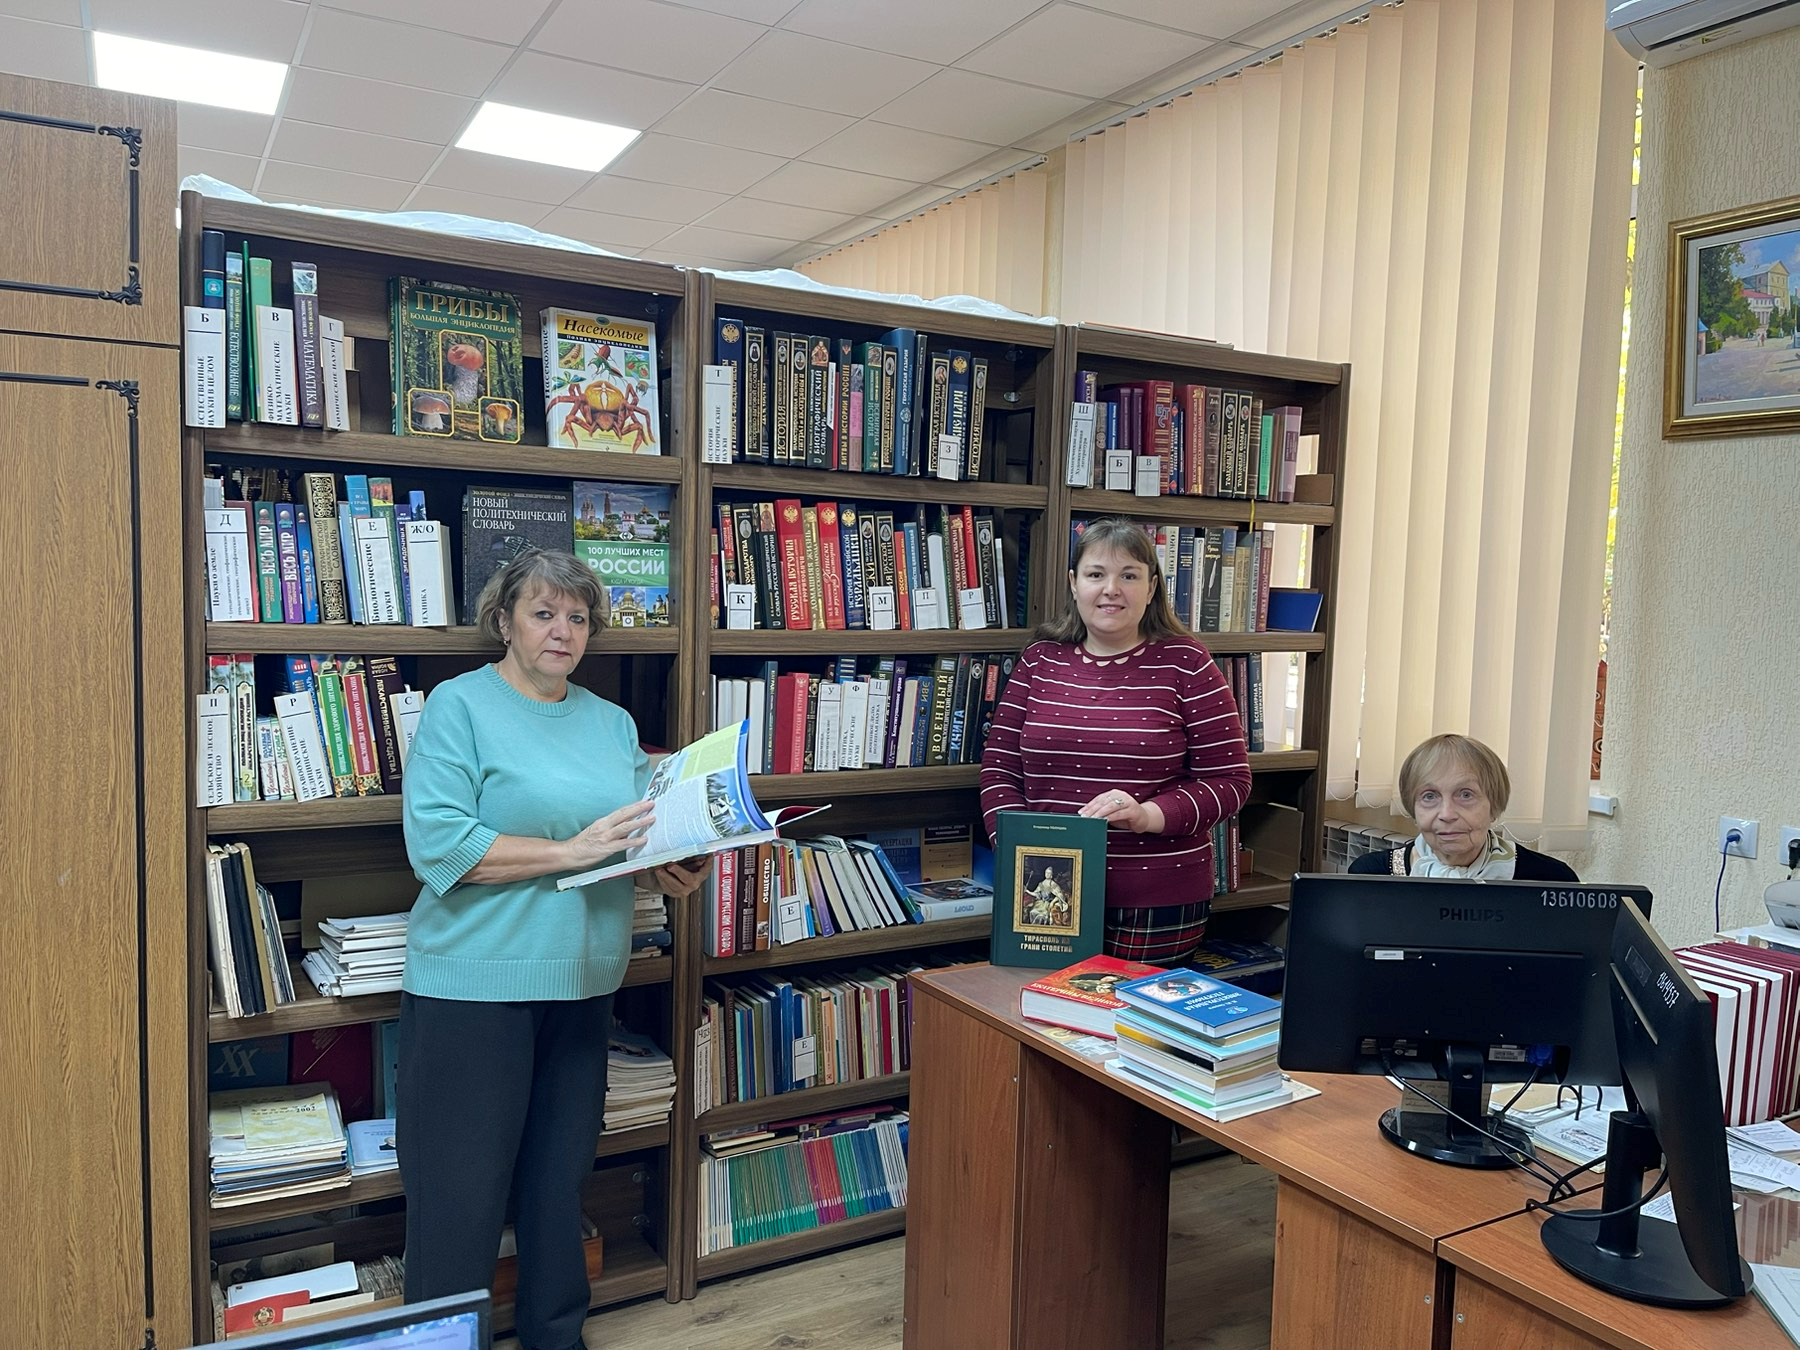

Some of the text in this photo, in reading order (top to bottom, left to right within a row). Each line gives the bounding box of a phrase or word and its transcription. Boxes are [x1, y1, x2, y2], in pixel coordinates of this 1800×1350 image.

[200, 312, 210, 322] Б
[272, 312, 279, 322] В
[416, 290, 510, 324] ГРИБЫ
[329, 322, 334, 332] Г
[410, 312, 516, 334] БОЛЬШАЯ ЭНЦИКЛОПЕДИЯ
[564, 319, 644, 342] Насекомые
[207, 356, 216, 387] ЦЕЛОМ
[229, 332, 239, 396] ЕСТЕСТВОЗНАНИЕ
[302, 340, 316, 406] МАТЕМАТИКА
[543, 329, 551, 399] Насекомые
[197, 356, 205, 426] ЕСТЕСТВЕННЫЕ
[274, 340, 282, 421] МАТЕМАТИЧЕСКИЕ
[842, 364, 850, 397] РОССИИ
[266, 384, 274, 421] ФИЗИКО-
[284, 394, 292, 423] НАУКИ
[332, 373, 342, 428] ХИМИЧЕСКИЕ
[814, 370, 822, 454] БИОГРАФИЧЕСКИЙ
[952, 390, 963, 418] ЦАРИ
[1078, 405, 1088, 414] Ш
[777, 405, 786, 455] ИСТОРИЯ
[840, 442, 848, 465] БИТВЫ
[971, 426, 980, 473] ИСТОРИЯ
[1146, 458, 1152, 466] В
[473, 496, 508, 508] НОВЫЙ
[473, 509, 567, 522] ПОЛИТЕХНИЧЕСКИЙ
[220, 514, 231, 526] Д
[368, 522, 377, 531] Е
[411, 525, 434, 534] Ж/О
[473, 520, 515, 530] СЛОВАРЬ
[210, 548, 218, 573] земле
[258, 526, 276, 574] ВЕСЬ МИР
[281, 532, 297, 581] ВЕСЬ МИР
[315, 520, 328, 579] ГЕОГРАФИЧЕСКИЙ
[330, 529, 340, 568] СЛОВАРЬ
[399, 527, 409, 573] ЗАГАДОЧНЫХ
[604, 548, 641, 556] ЛУЧШИХ
[643, 549, 664, 557] МЕСТ
[785, 539, 795, 579] ИСТОРИЯ
[843, 534, 852, 577] РОССИЙСКОЙ
[304, 565, 312, 582] ВЕСЬ
[588, 558, 665, 575] РОССИИ
[805, 530, 818, 611] ДОМАШНЯЯ ЖИЗНЬ
[851, 534, 864, 607] ГЕРАЛЬДИКИ
[982, 545, 992, 585] СЛОВАРЬ
[212, 581, 220, 607] Науки
[364, 543, 380, 622] Биологические
[384, 591, 394, 621] науки
[736, 595, 745, 604] К
[788, 581, 800, 620] РУССКАЯ
[878, 596, 887, 605] М
[210, 698, 217, 707] П
[405, 696, 412, 705] С
[892, 693, 900, 737] Конституционное
[932, 675, 948, 752] ВОЕННЫЙ
[376, 679, 397, 773] ЛЕКАРСТВЕННЫЕ СРЕДСТВА
[941, 698, 951, 752] ЭНЦИКЛОПЕДИЧЕСКИЙ
[950, 710, 965, 750] КНИГА
[287, 725, 310, 799] ЗДРАВООХРАНЕНИЕ
[300, 738, 318, 797] МЕДИЦИНСКИЕ
[215, 755, 223, 803] ХОЗЯЙСТВО
[243, 774, 250, 783] 2
[315, 768, 327, 795] НАУКИ
[762, 859, 770, 903] ОБЩЕСТВО
[787, 906, 794, 915] Е
[1440, 907, 1505, 922] PHILIPS
[1540, 890, 1617, 909] 13610608
[1020, 943, 1072, 953] ГРАНИ СТОЛЕТИЙ
[1024, 935, 1060, 944] ТИРАСПОЛЬ
[1031, 983, 1124, 1007] ЕКАТЕРИНЫ ВЕЛИКОЙ
[802, 1040, 807, 1049] Е
[214, 1044, 260, 1078] XX
